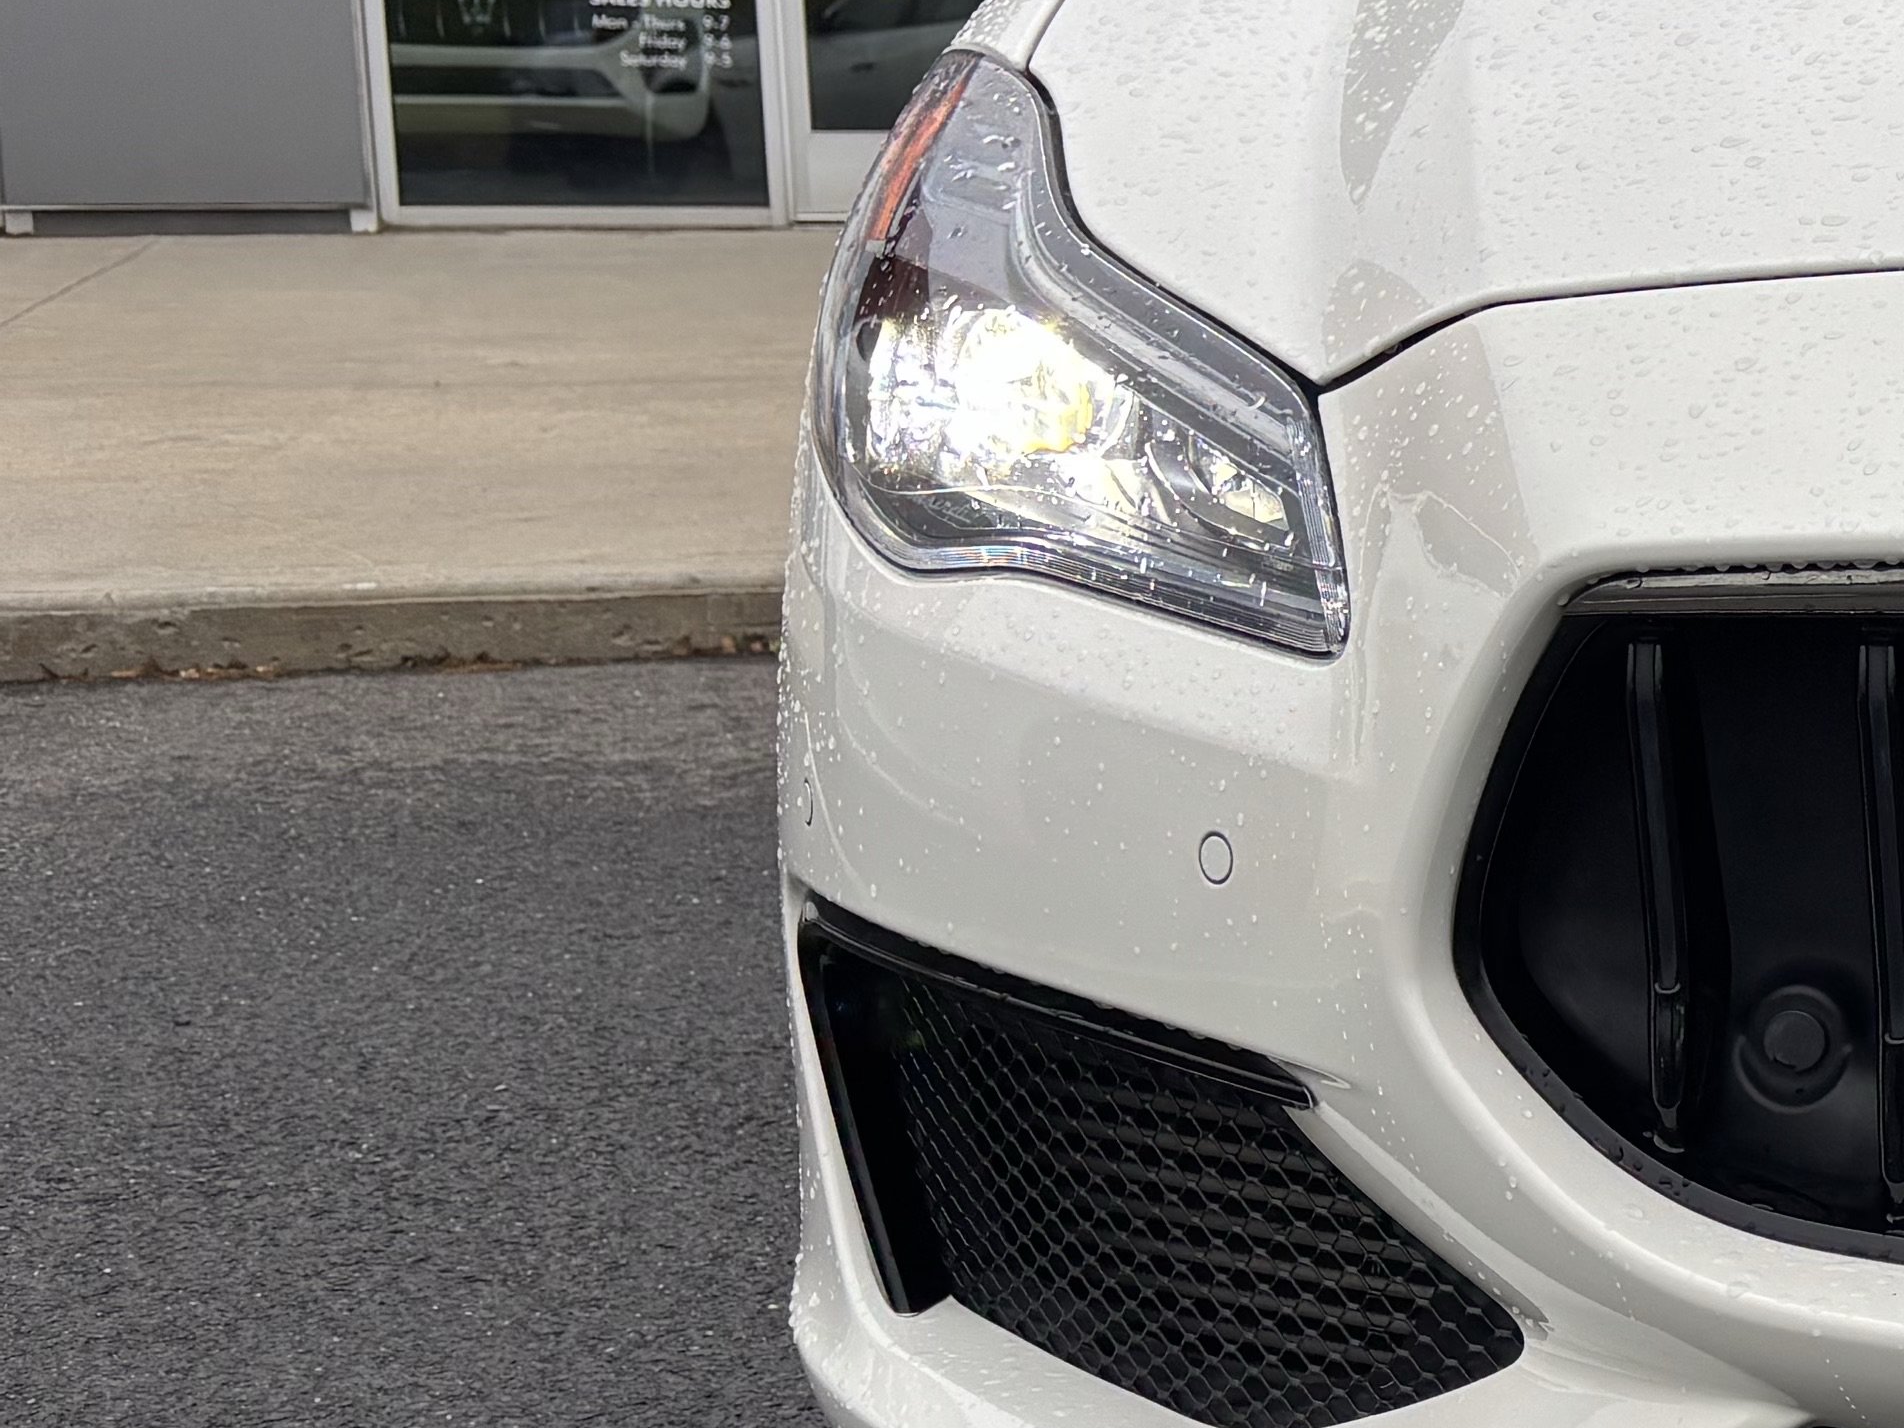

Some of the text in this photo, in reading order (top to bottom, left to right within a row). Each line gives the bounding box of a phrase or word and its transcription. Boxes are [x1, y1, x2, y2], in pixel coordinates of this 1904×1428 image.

[591, 13, 629, 30] Mon
[643, 13, 686, 31] Thurs
[638, 31, 687, 52] Friday
[620, 50, 688, 70] Saturday
